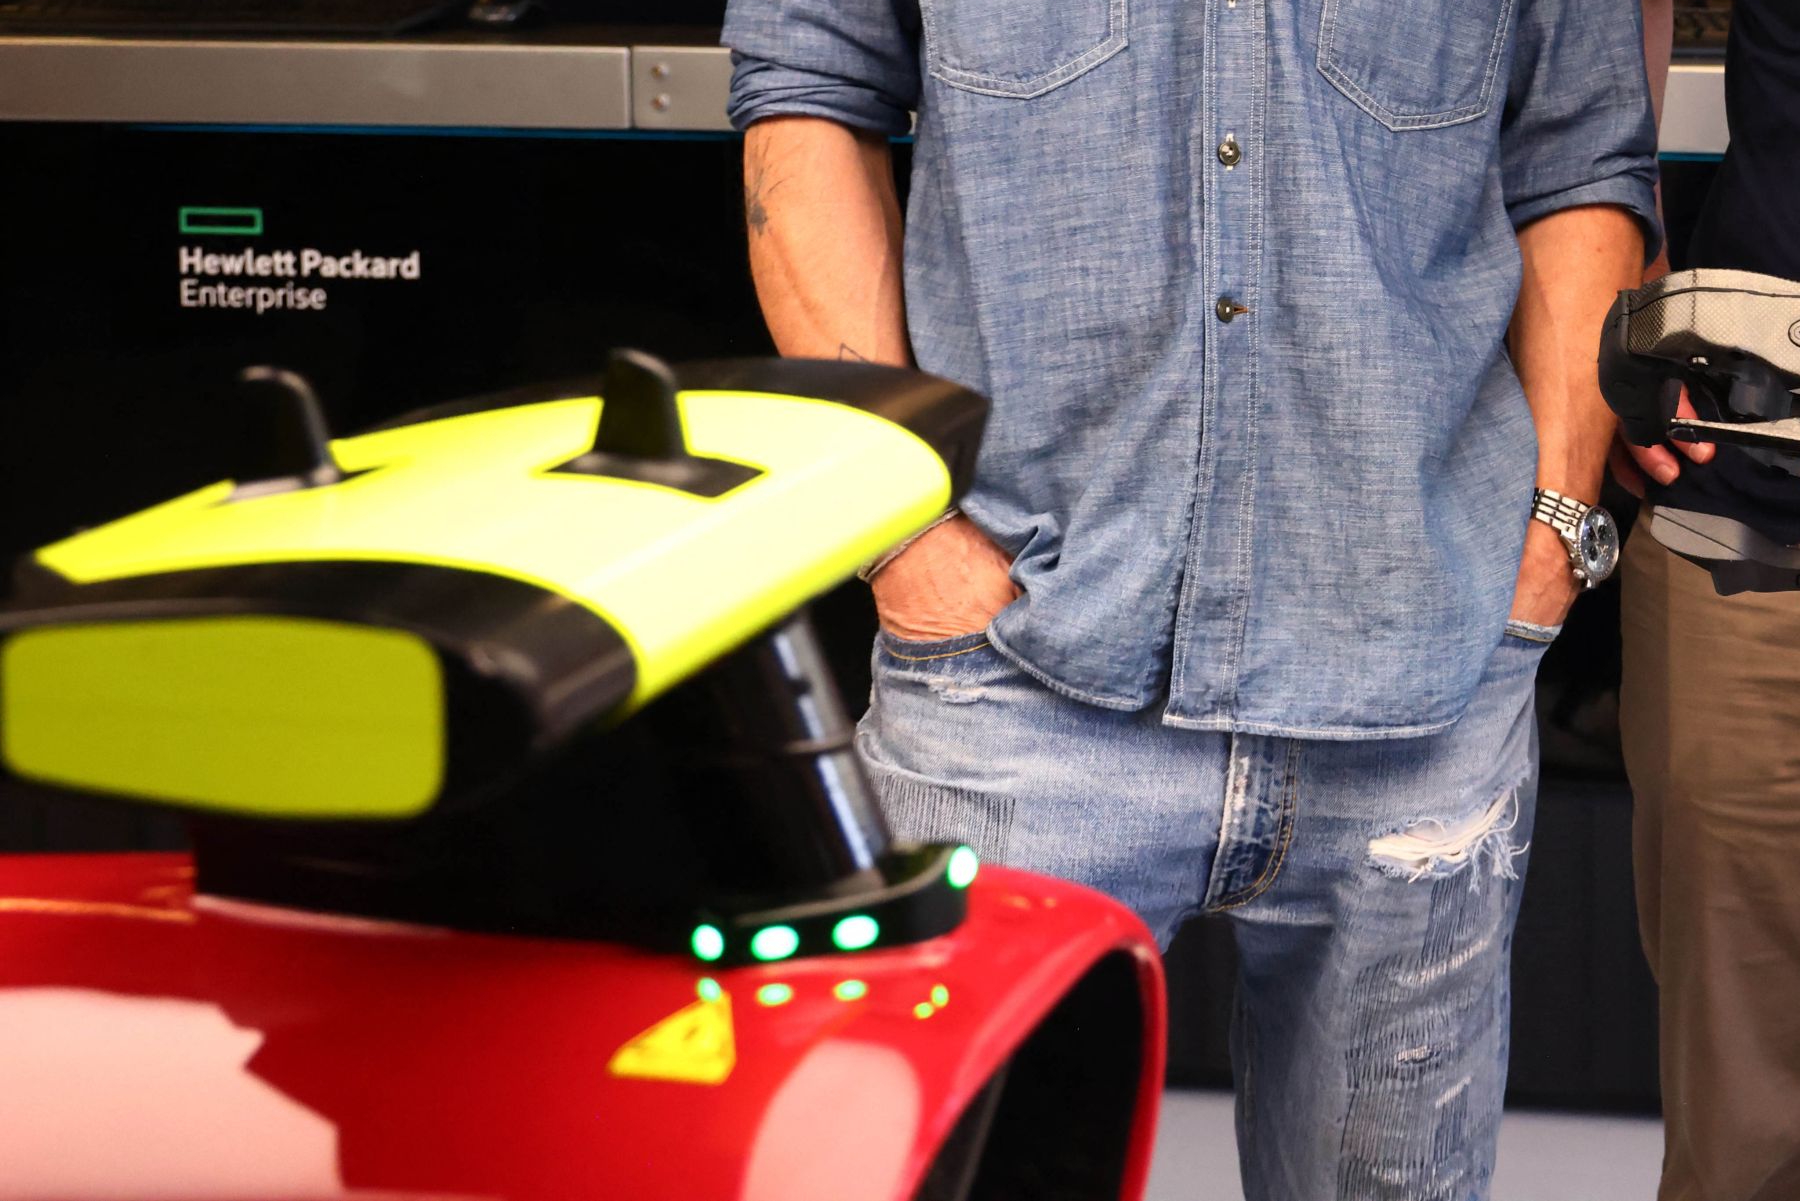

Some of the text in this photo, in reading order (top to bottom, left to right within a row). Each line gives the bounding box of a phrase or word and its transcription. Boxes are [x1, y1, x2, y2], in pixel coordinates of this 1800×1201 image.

[179, 246, 421, 280] Hewlett Packard
[179, 278, 328, 315] Enterprise
